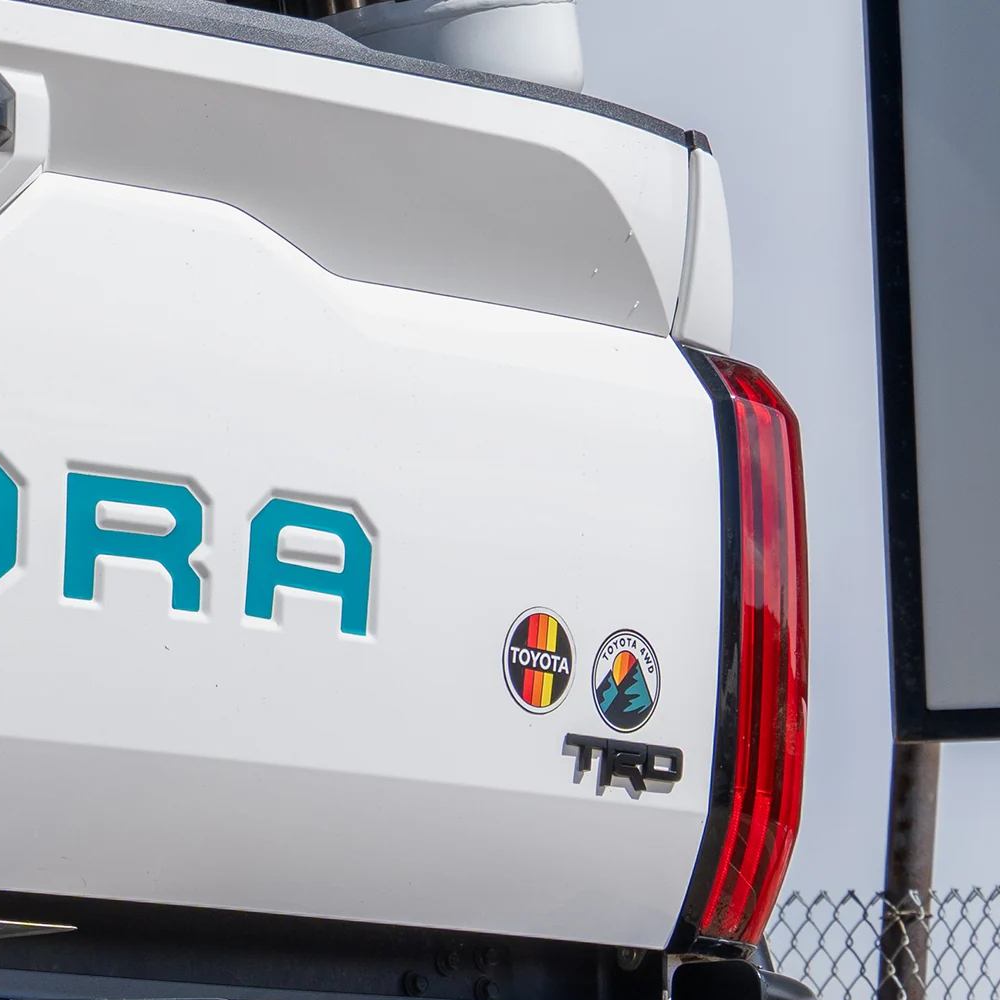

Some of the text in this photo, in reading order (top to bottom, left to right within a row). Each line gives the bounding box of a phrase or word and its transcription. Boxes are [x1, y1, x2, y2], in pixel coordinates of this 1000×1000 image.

[510, 646, 570, 674] TOYOTA
[602, 637, 655, 675] TOYOTA 4WD
[564, 732, 685, 792] TRD
